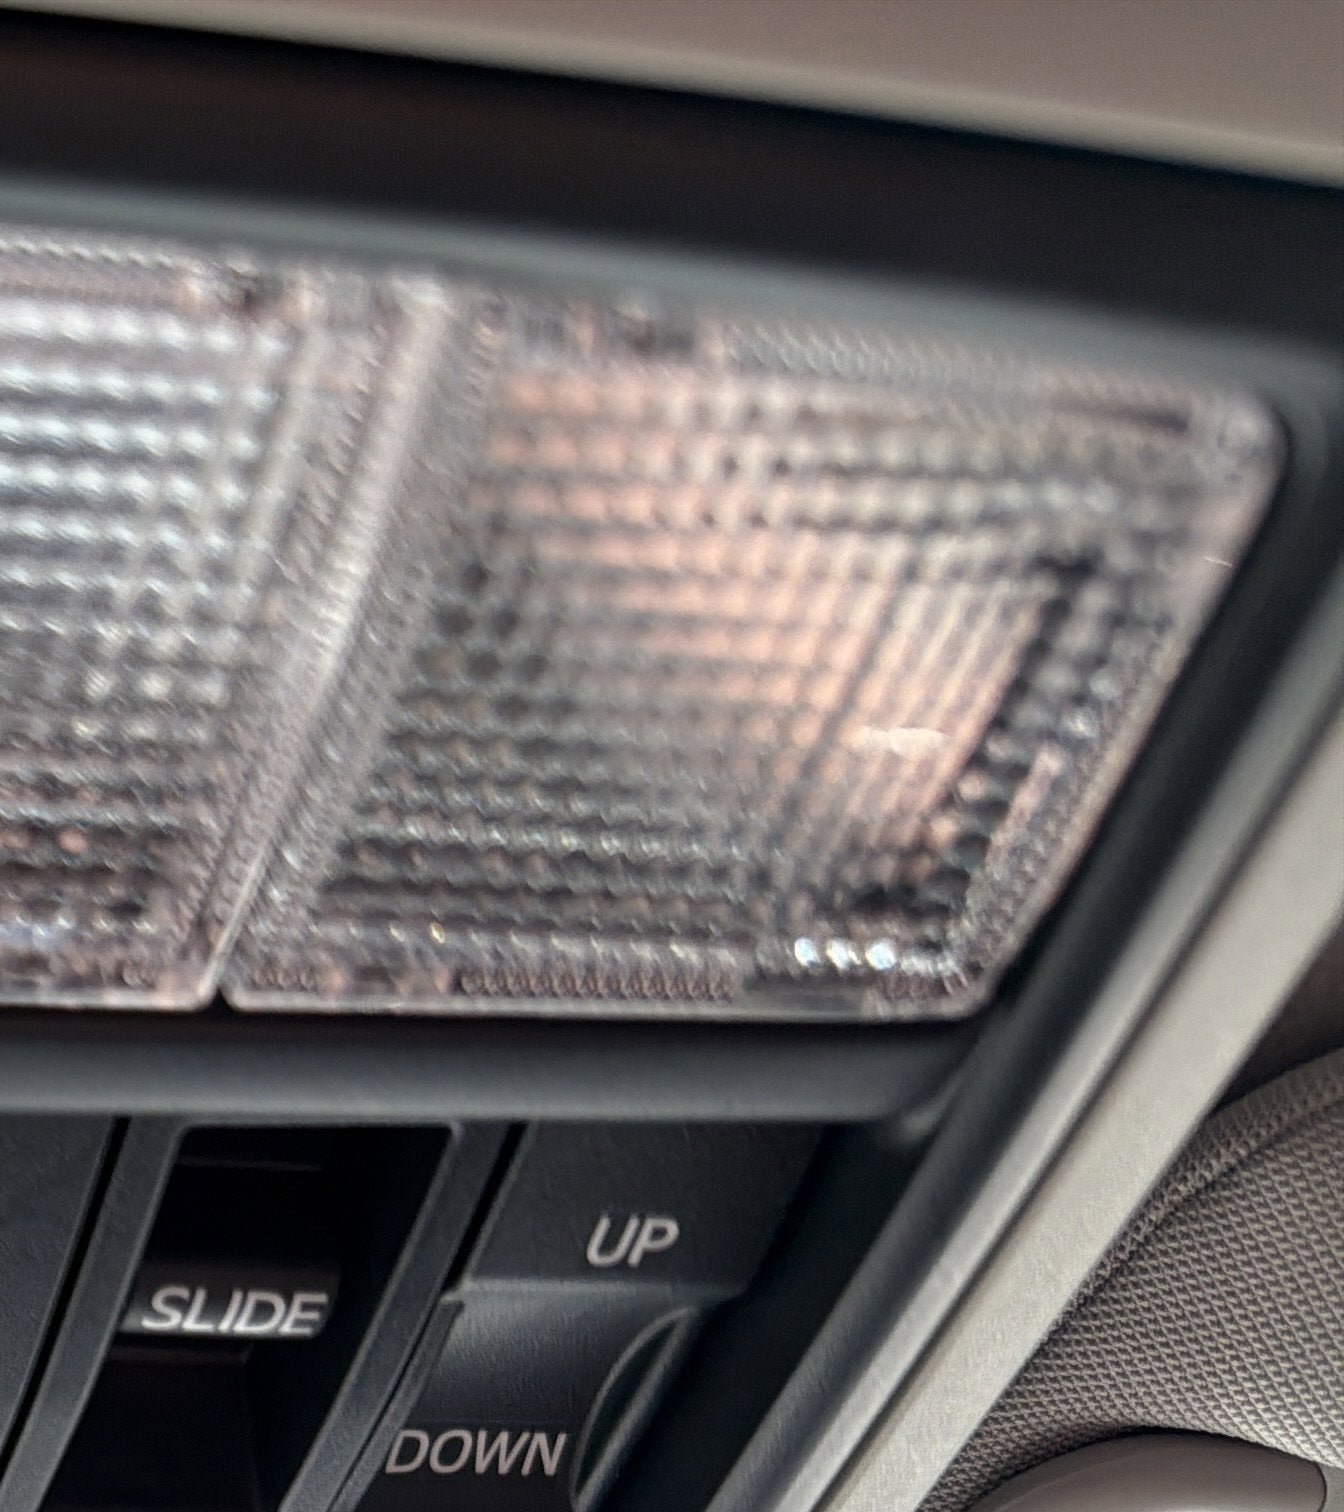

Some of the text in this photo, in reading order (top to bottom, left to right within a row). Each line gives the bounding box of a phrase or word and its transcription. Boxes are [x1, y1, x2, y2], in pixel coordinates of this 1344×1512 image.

[585, 1212, 679, 1269] UP
[139, 1284, 329, 1338] SLIDE
[384, 1429, 567, 1477] DOWN
